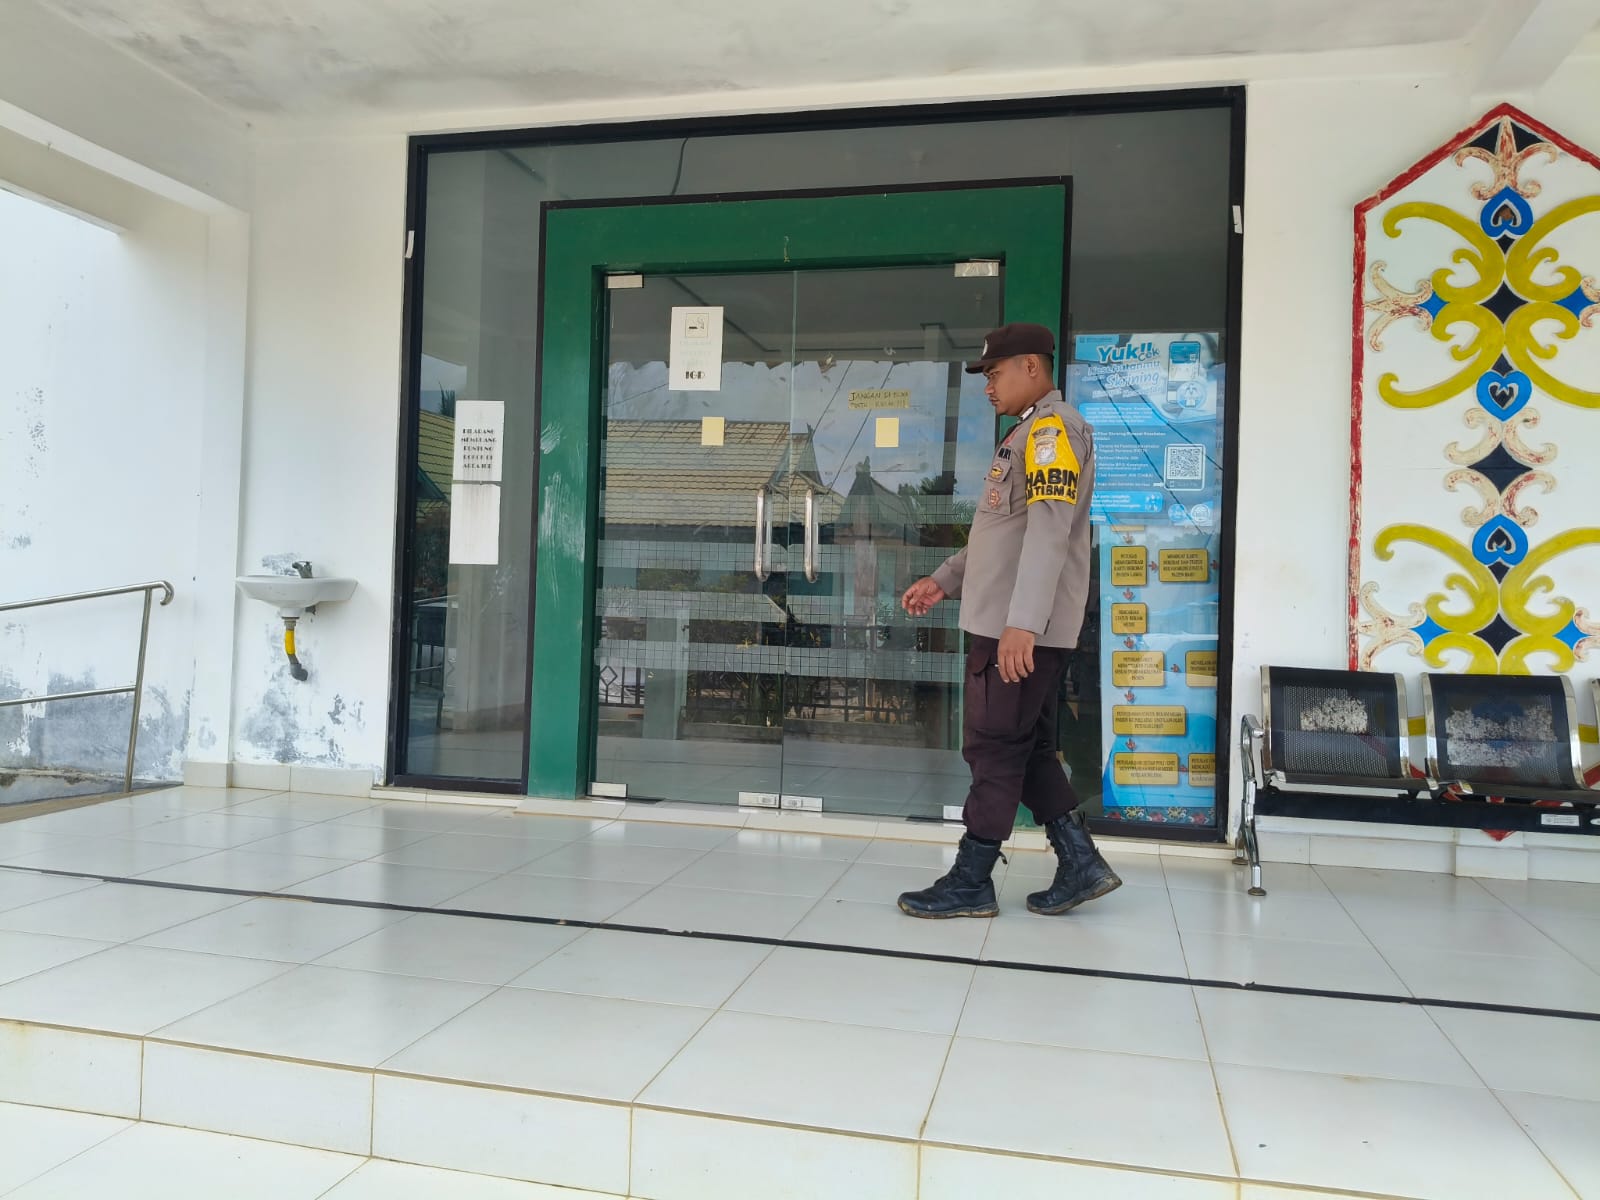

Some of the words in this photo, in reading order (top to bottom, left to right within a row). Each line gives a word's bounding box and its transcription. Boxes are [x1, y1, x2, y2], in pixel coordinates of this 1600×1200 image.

[1098, 342, 1153, 364] Yuk!!
[1139, 347, 1159, 361] Cek
[685, 371, 706, 380] IGD
